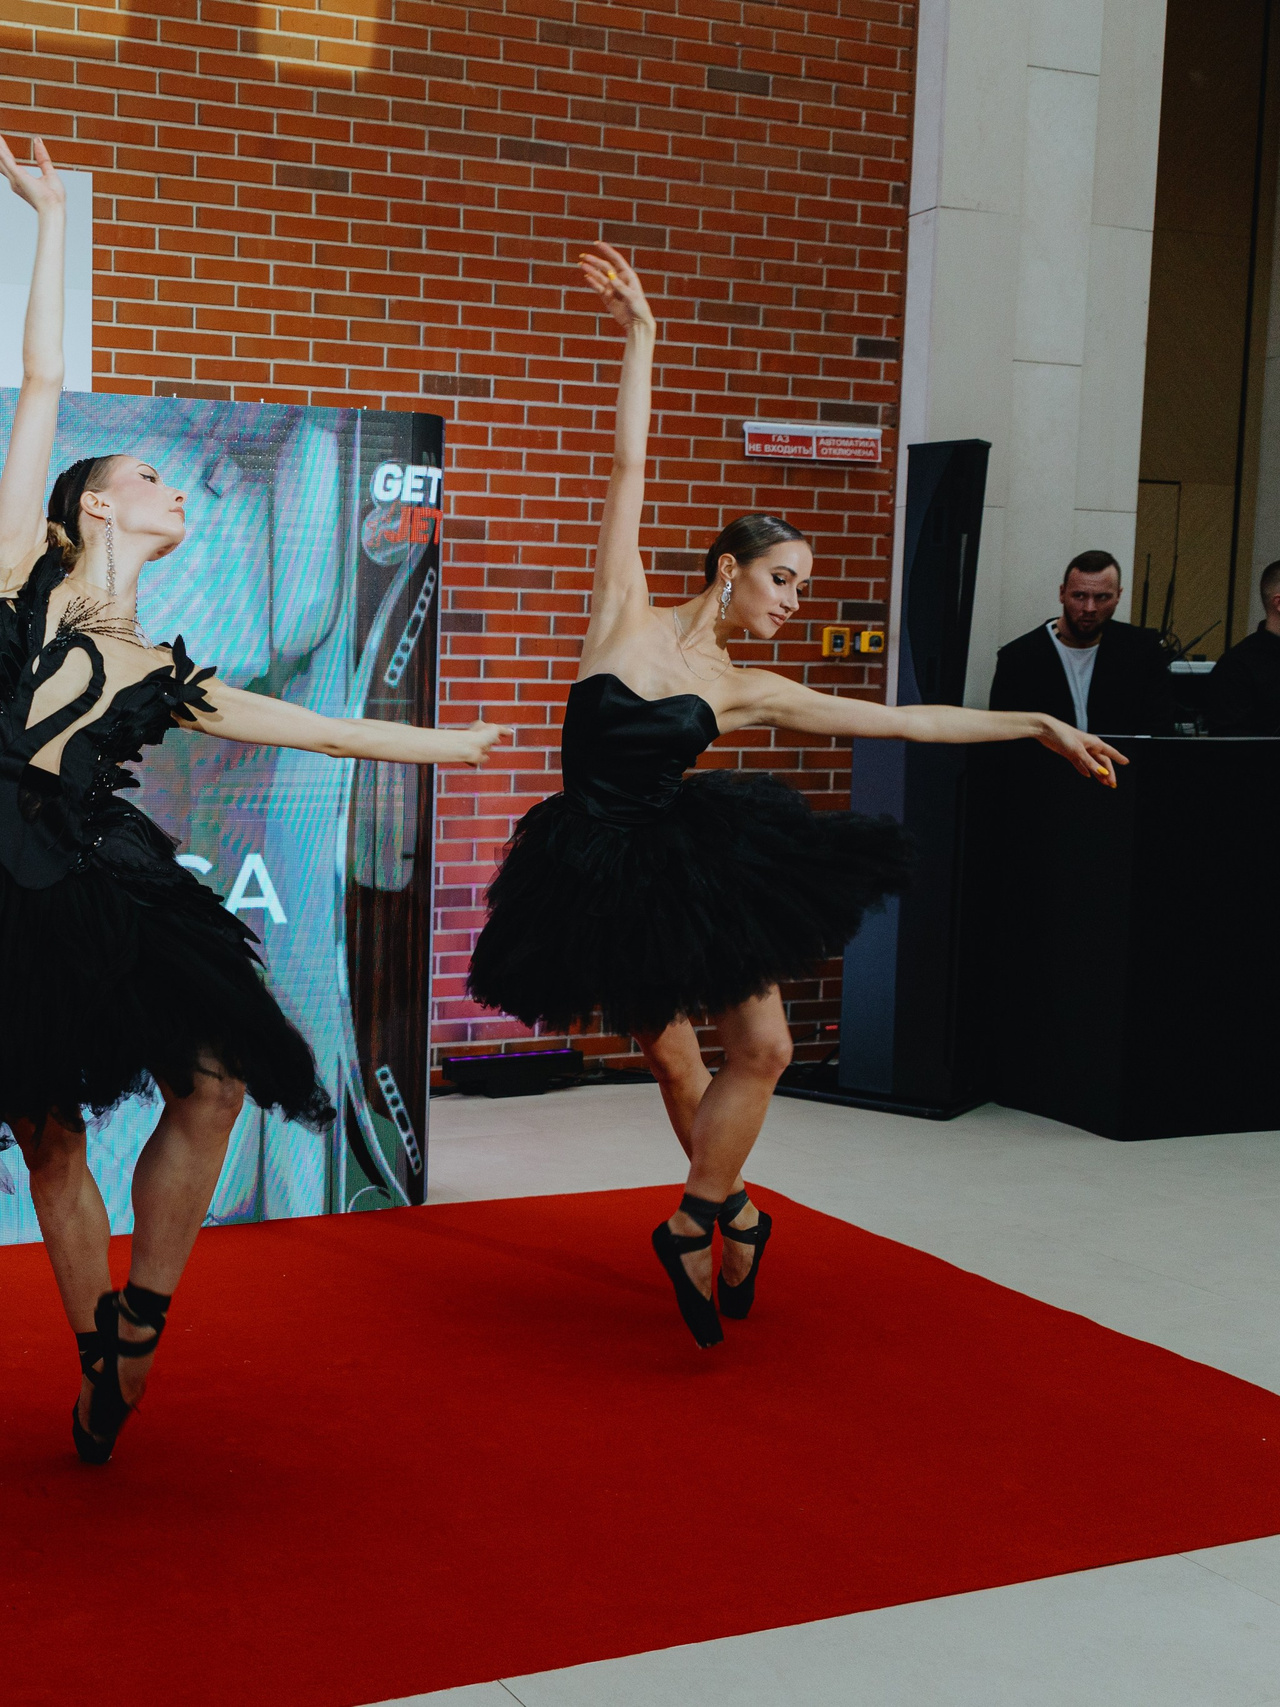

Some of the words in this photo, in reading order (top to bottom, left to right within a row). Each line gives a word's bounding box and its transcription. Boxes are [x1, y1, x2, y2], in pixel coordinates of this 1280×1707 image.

[771, 434, 789, 443] ГАЗ
[818, 438, 876, 448] АВТОМАТИКА
[748, 444, 762, 453] НЕ
[764, 445, 813, 455] ВХОДИТЬ!
[821, 447, 875, 457] ОТКЛЮЧЕНА
[373, 463, 443, 505] GET
[384, 507, 443, 545] JET
